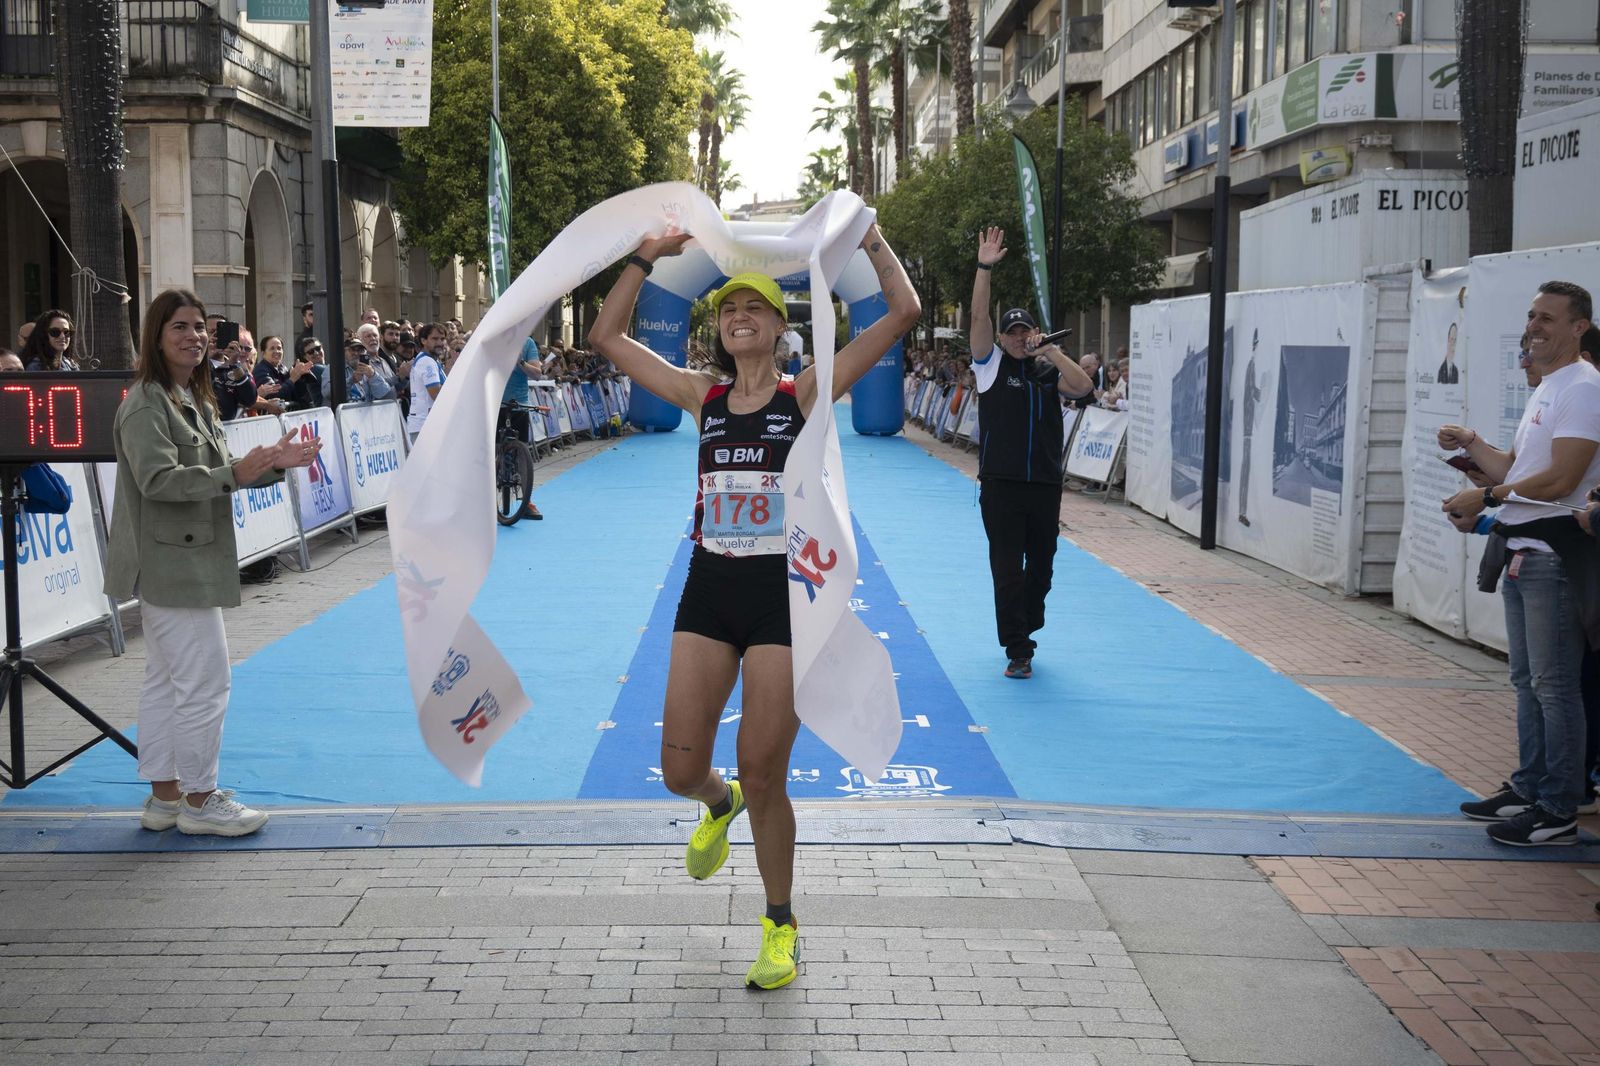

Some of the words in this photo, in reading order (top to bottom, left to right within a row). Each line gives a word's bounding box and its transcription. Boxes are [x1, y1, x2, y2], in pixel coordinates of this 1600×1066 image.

[261, 6, 309, 17] HUELVA
[339, 42, 365, 51] apavt
[1534, 71, 1575, 81] Planes
[1576, 70, 1592, 81] de
[1533, 85, 1594, 96] Familiares
[1323, 105, 1338, 119] La
[1342, 104, 1367, 117] Paz
[1521, 141, 1535, 168] EL
[1539, 129, 1581, 166] PICOTE
[1377, 189, 1403, 211] EL
[638, 317, 680, 333] Huelva
[760, 434, 795, 442] emteSPORT
[366, 449, 399, 477] HUELVA
[732, 447, 765, 464] BM
[246, 482, 284, 514] HUELVA
[711, 493, 771, 527] 178
[715, 538, 755, 549] Huelva
[44, 562, 82, 595] original
